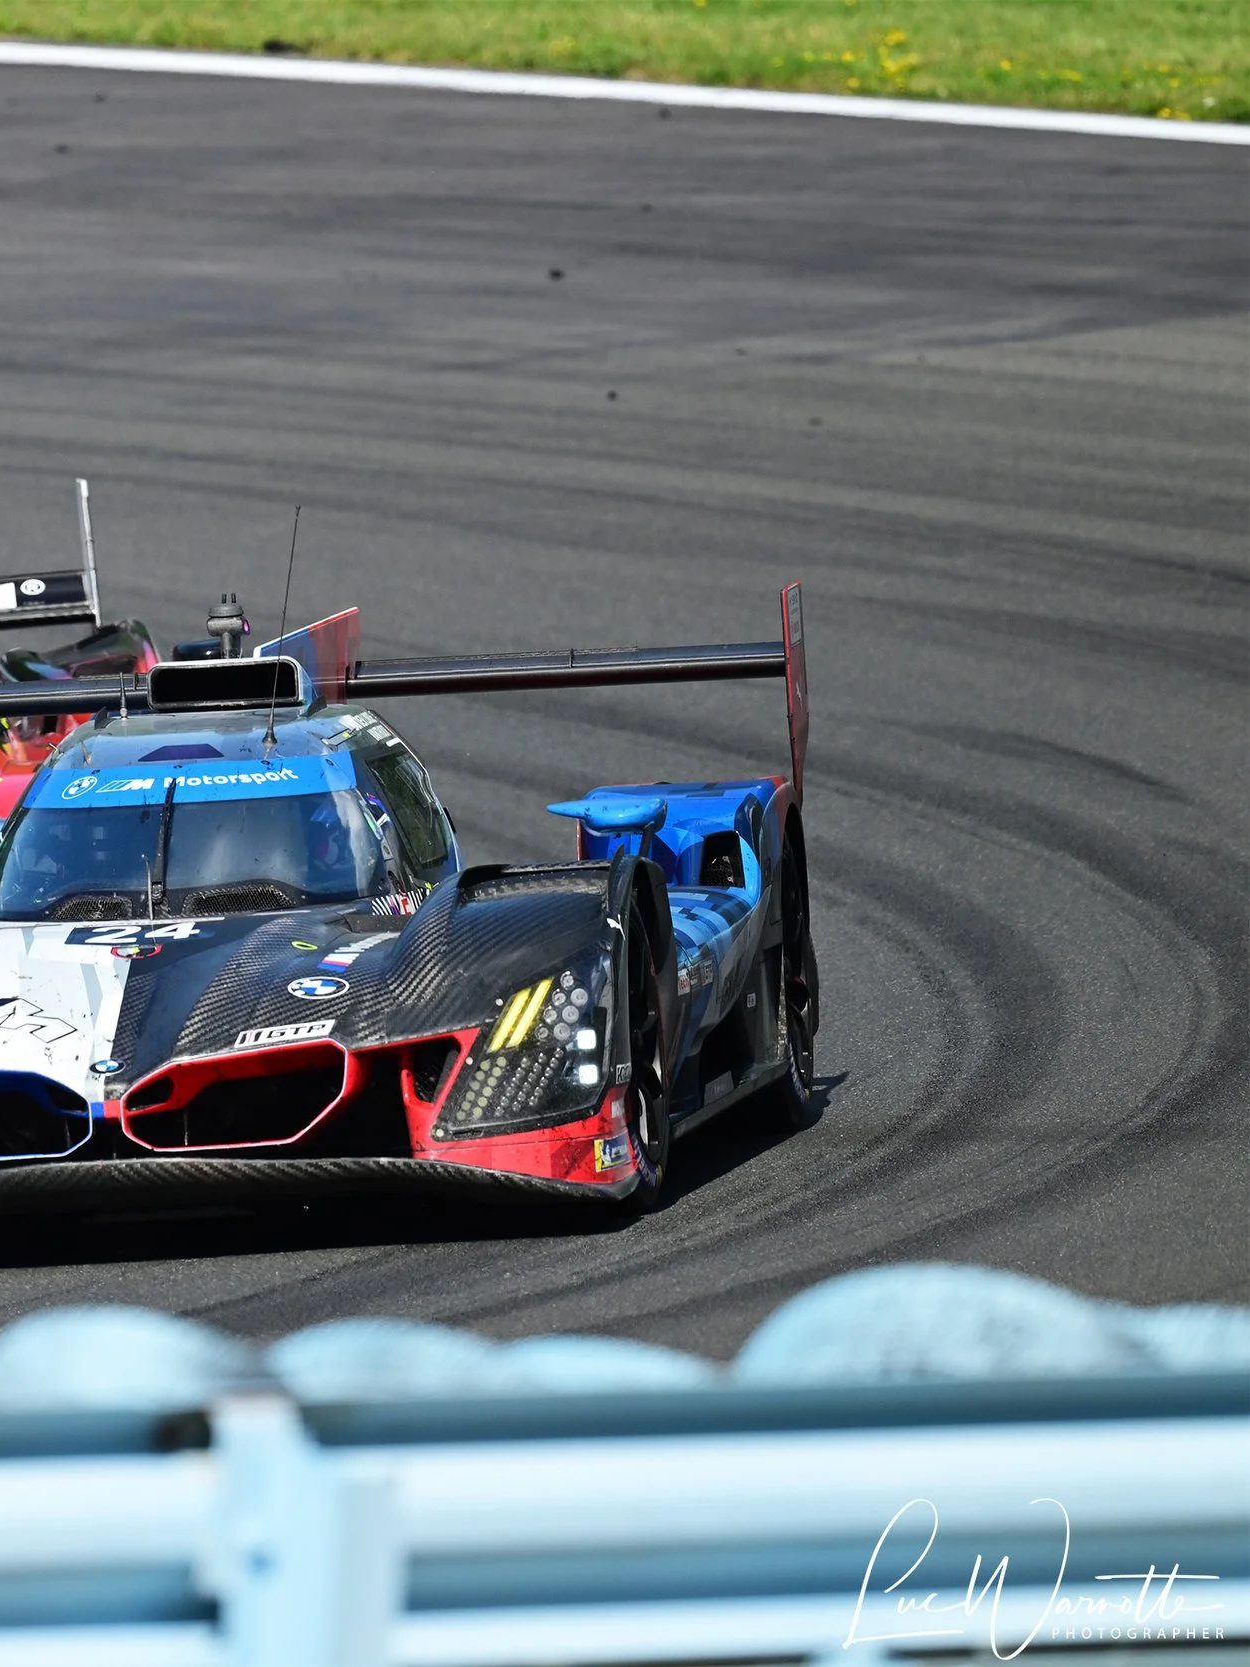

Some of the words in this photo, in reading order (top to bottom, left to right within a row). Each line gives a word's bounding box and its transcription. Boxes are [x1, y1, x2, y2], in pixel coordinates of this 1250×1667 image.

[164, 768, 298, 790] Motorsport
[84, 923, 201, 944] 24
[266, 1023, 326, 1039] GTP
